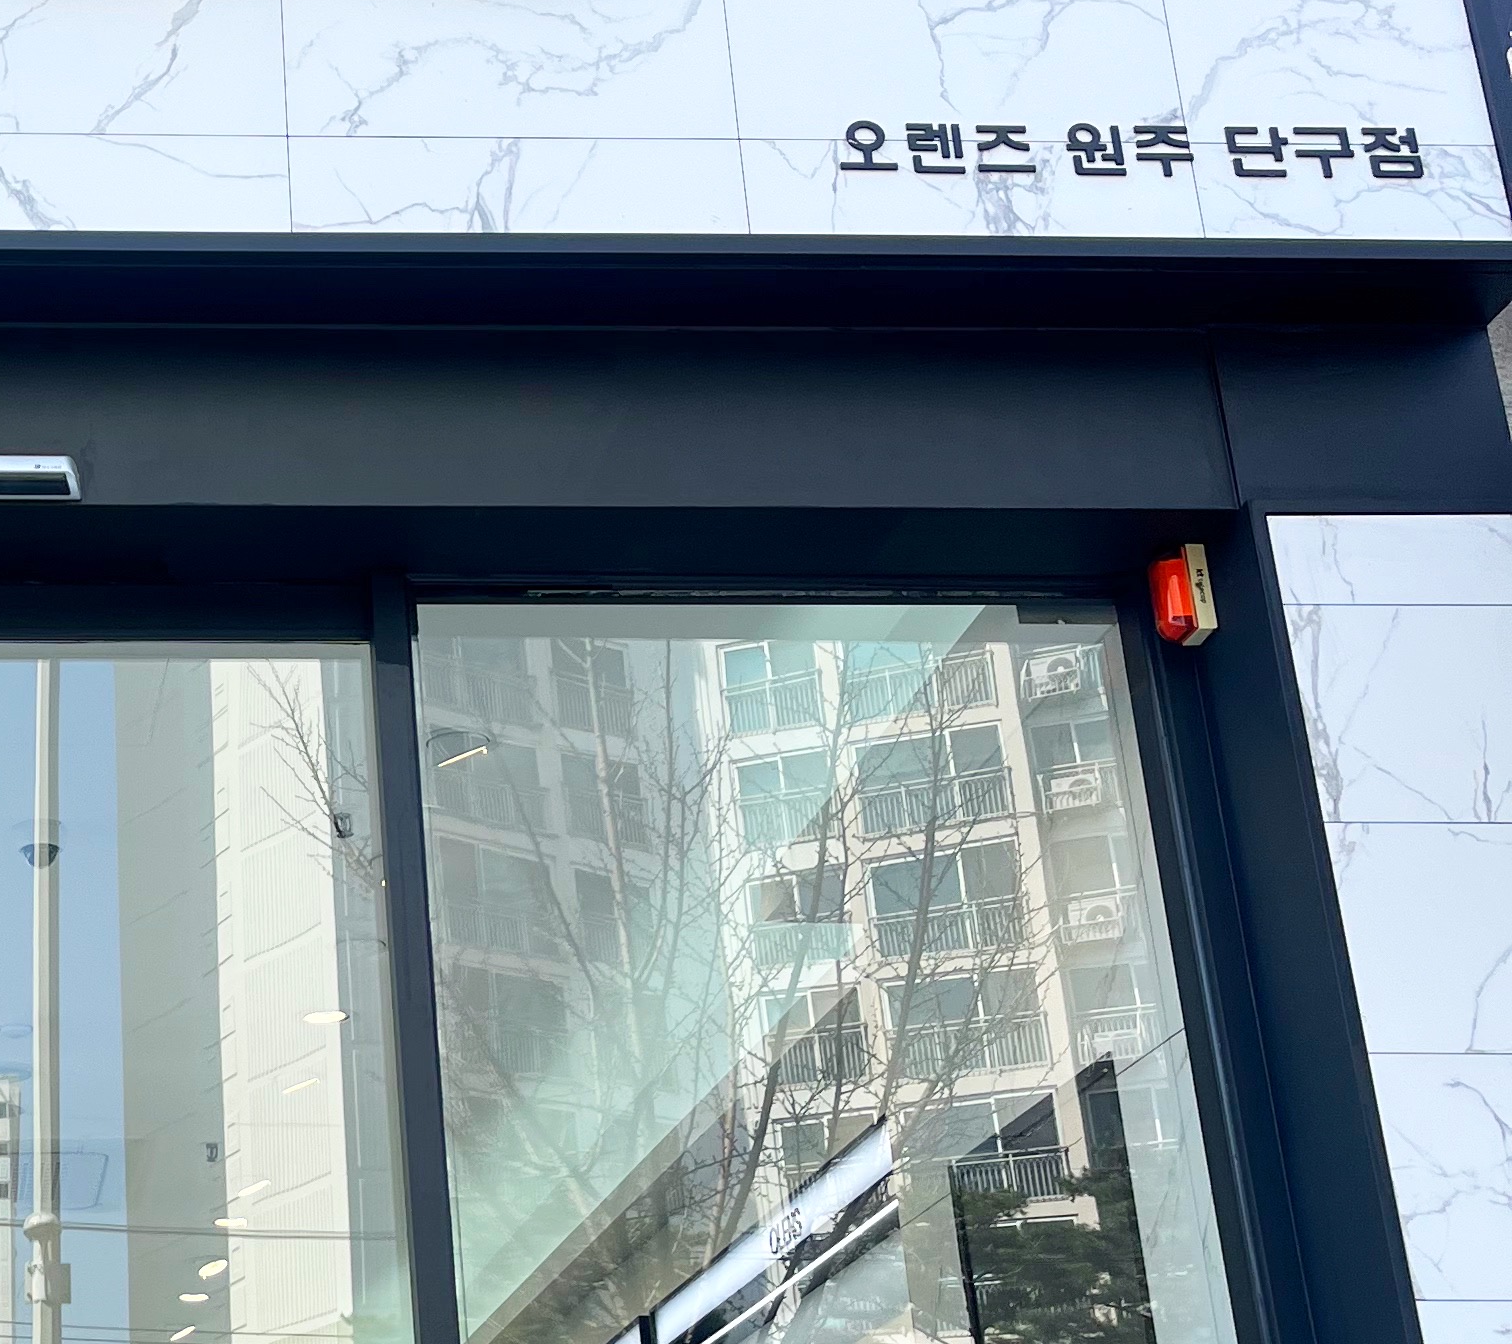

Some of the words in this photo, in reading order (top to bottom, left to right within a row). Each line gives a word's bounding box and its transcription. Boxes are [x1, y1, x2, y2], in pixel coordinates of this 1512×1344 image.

[840, 120, 1036, 174] 오렌즈
[1066, 122, 1194, 178] 원주
[1224, 126, 1425, 179] 단구점
